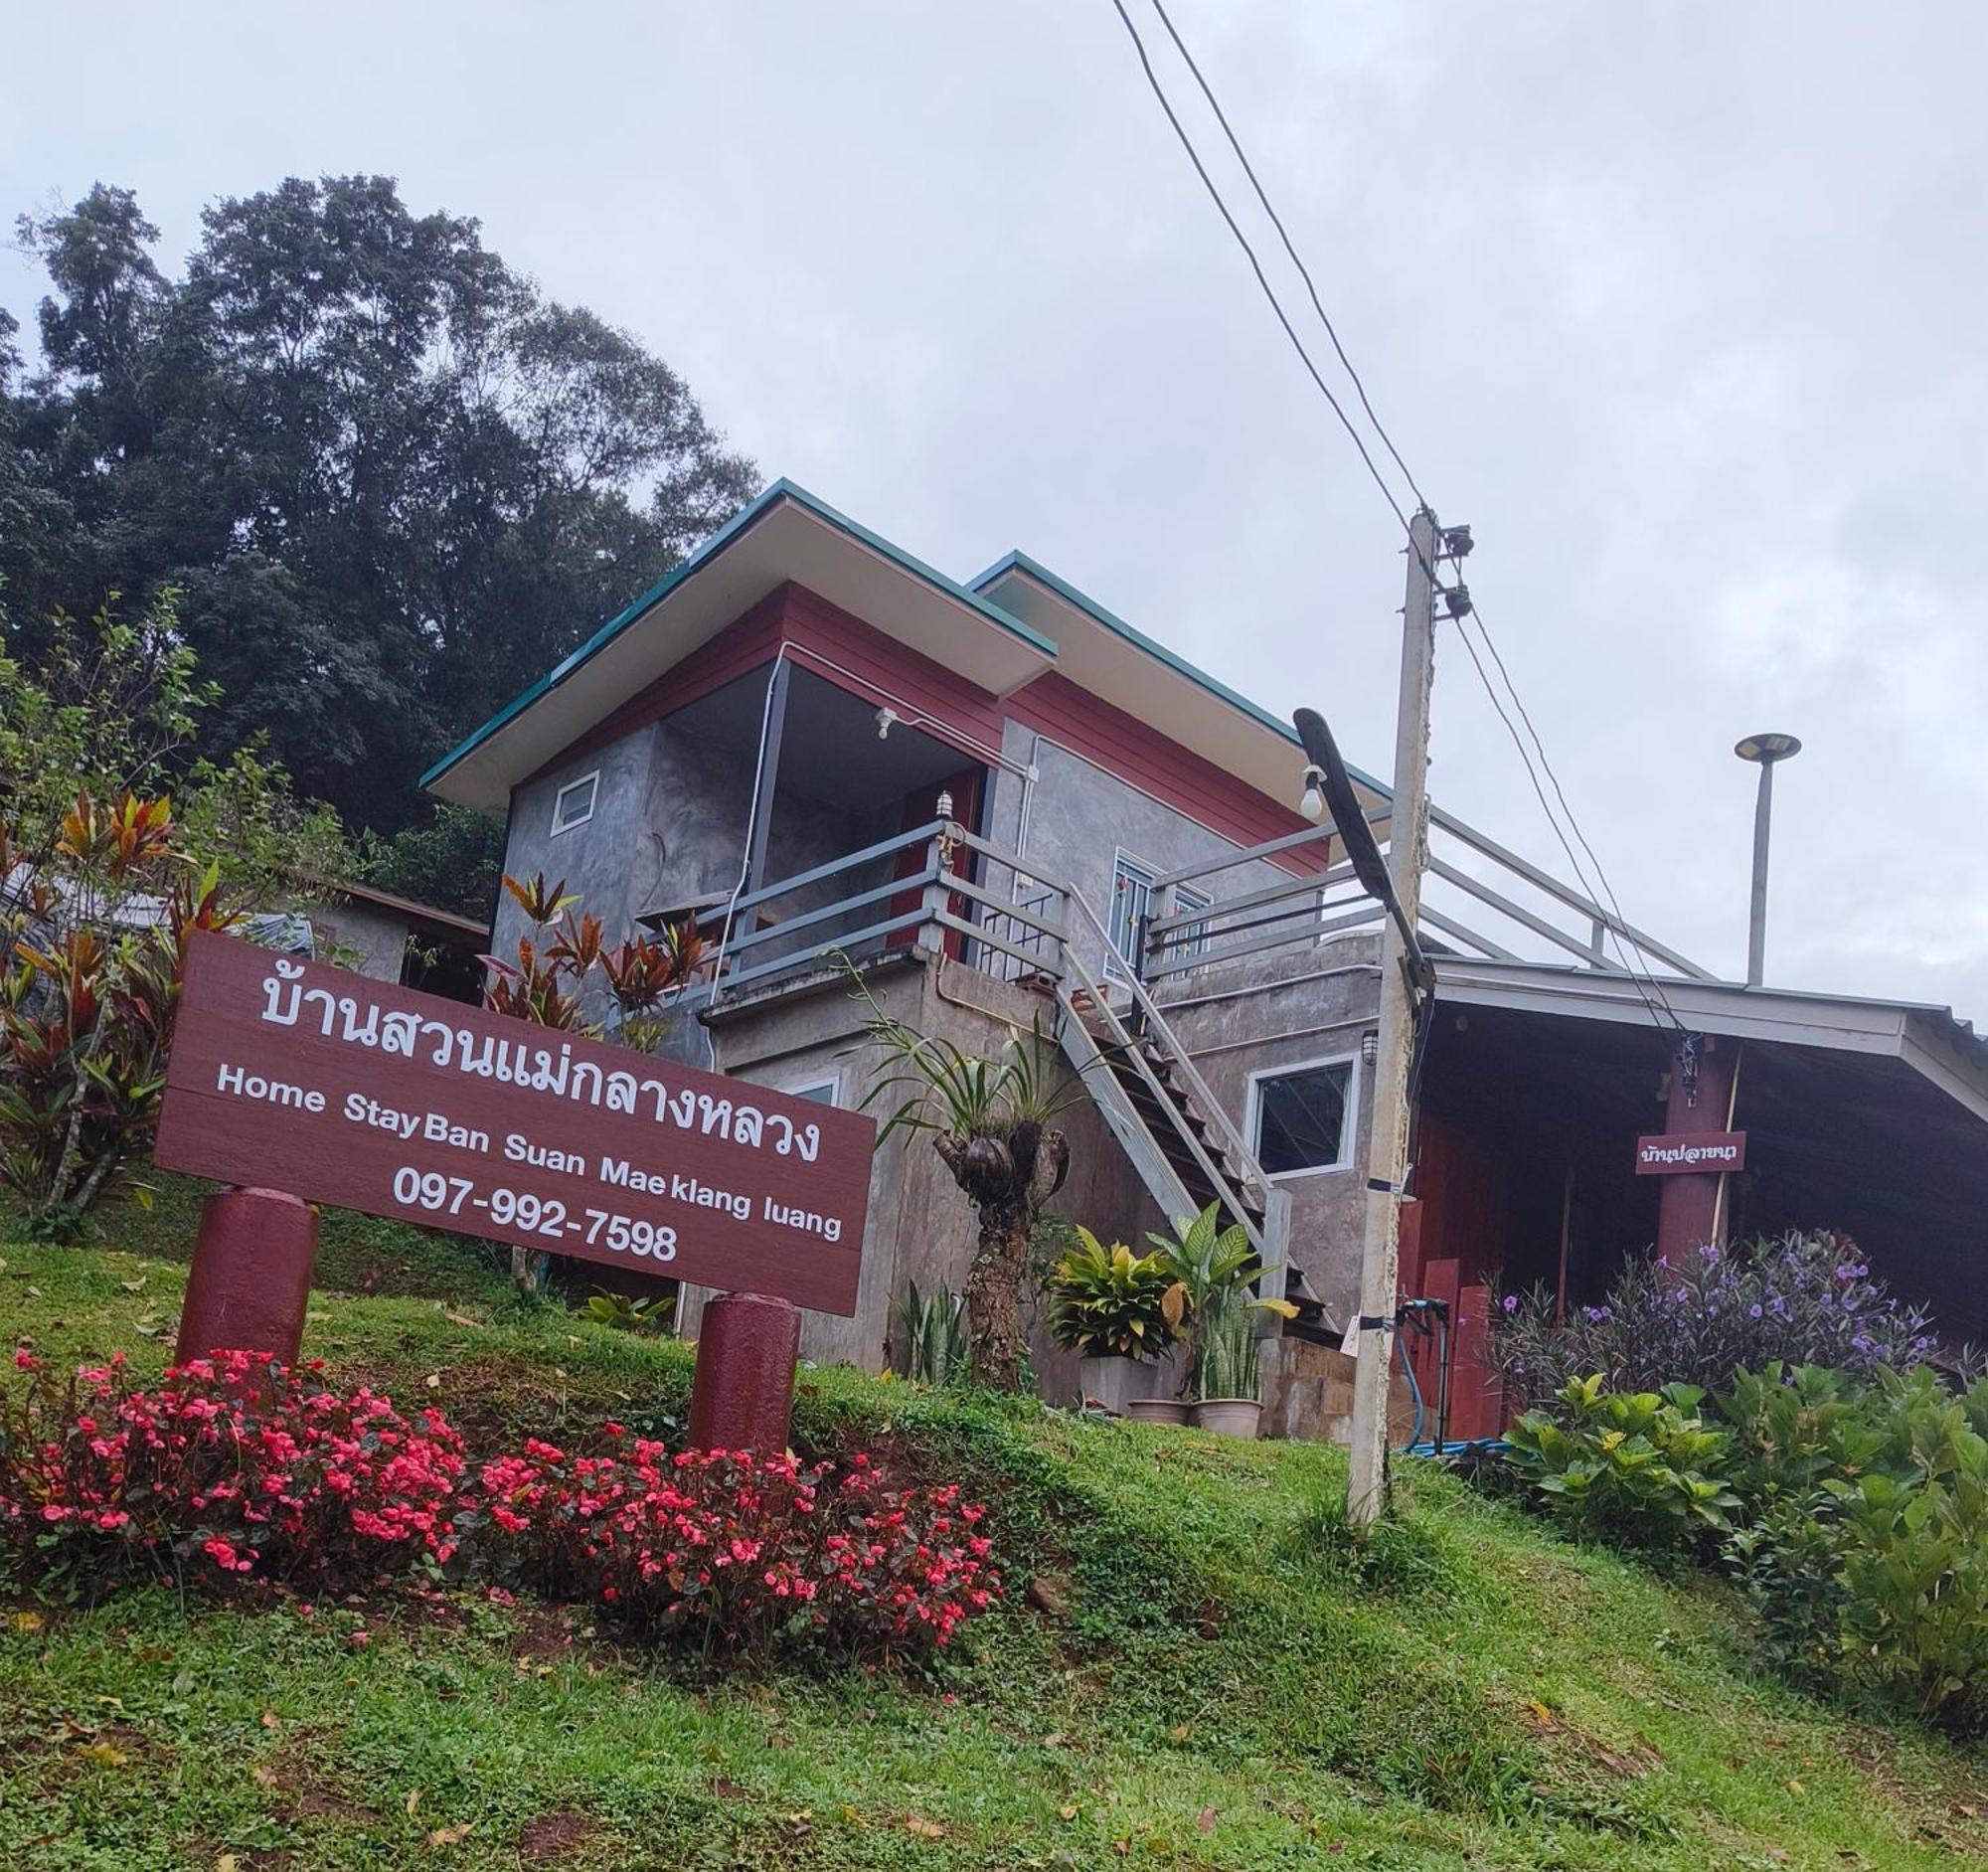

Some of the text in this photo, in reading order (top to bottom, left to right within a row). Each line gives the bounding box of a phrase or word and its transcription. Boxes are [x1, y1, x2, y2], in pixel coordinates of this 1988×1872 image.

[261, 960, 821, 1162] บ้านสวนแม่กลางหลวง
[217, 1063, 326, 1112] Home
[504, 1133, 586, 1176] Suan
[763, 1196, 843, 1243] luang
[393, 1166, 678, 1262] 097-992-7598
